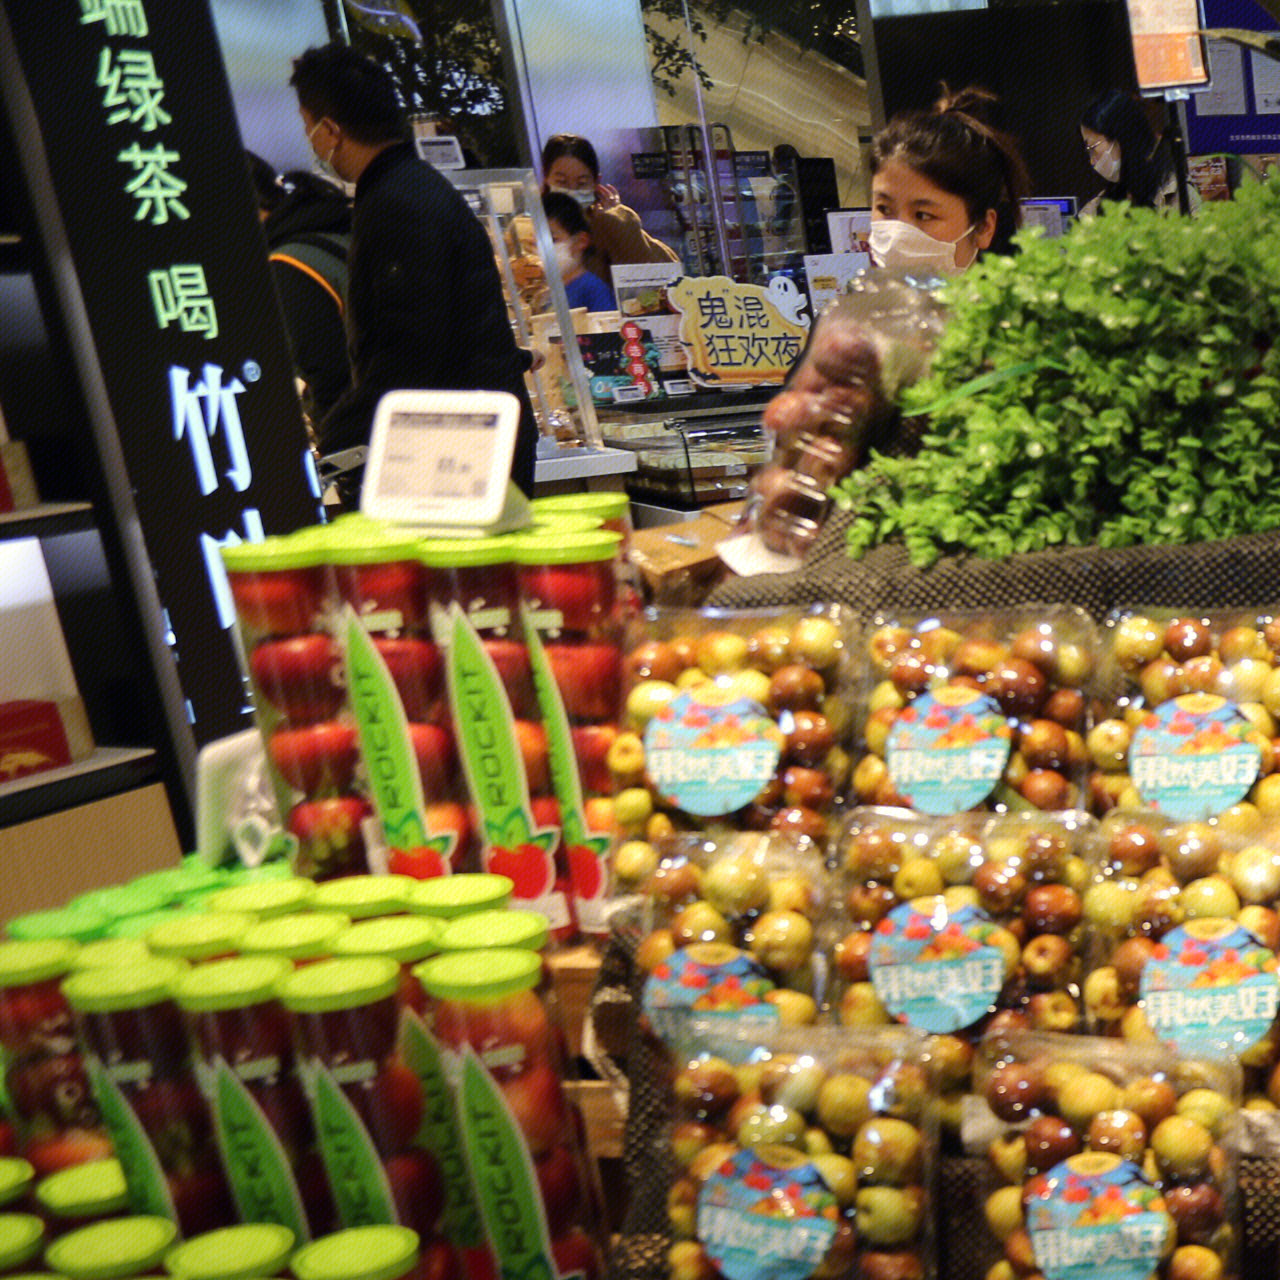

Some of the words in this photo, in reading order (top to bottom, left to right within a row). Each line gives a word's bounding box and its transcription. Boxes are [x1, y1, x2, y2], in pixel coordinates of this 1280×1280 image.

[147, 264, 219, 340] 喝
[704, 333, 803, 368] 狂欢夜
[355, 670, 401, 809] ROCKIT
[461, 667, 507, 807] ROCKIT
[1145, 981, 1280, 1027] 果然美好
[472, 1105, 528, 1256] ROCKIT
